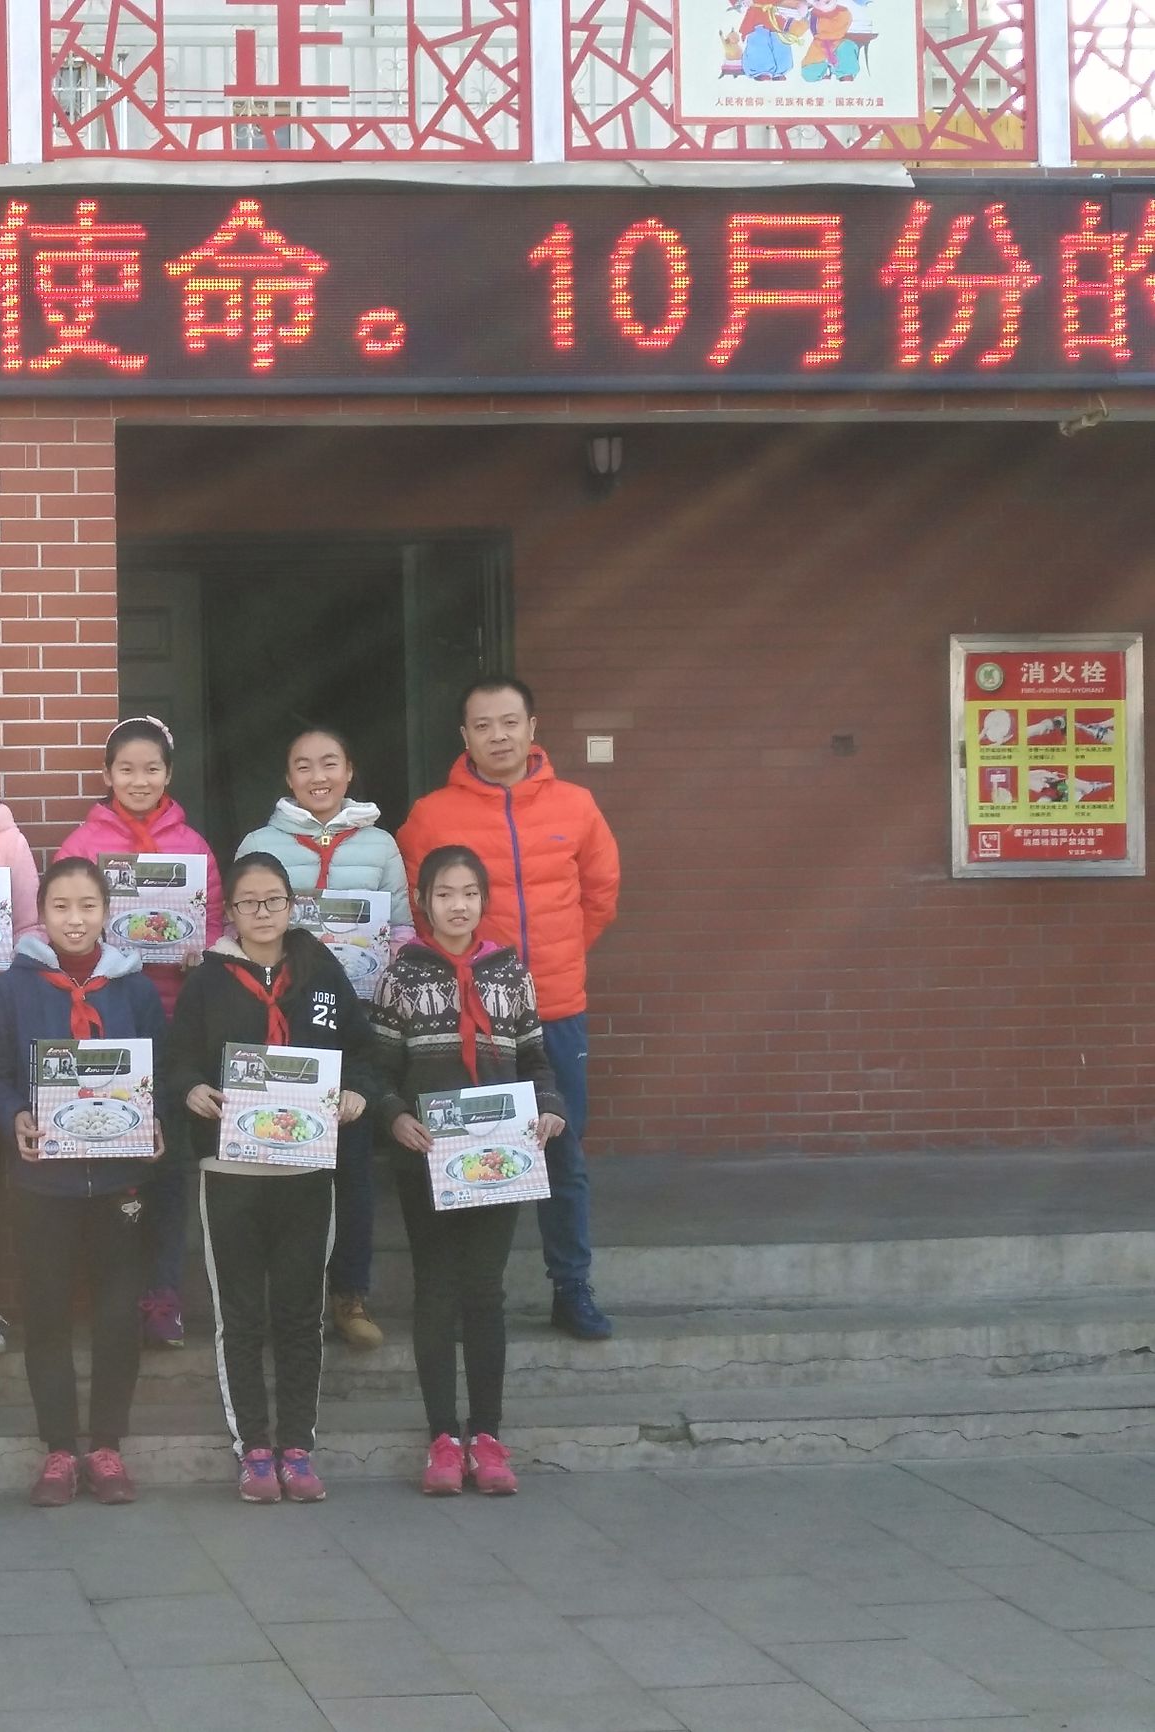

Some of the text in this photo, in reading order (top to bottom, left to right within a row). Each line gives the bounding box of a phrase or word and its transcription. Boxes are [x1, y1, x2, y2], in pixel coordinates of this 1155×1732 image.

[224, 0, 350, 97] 正
[1020, 661, 1107, 683] 消火栓
[312, 991, 336, 1005] JORD
